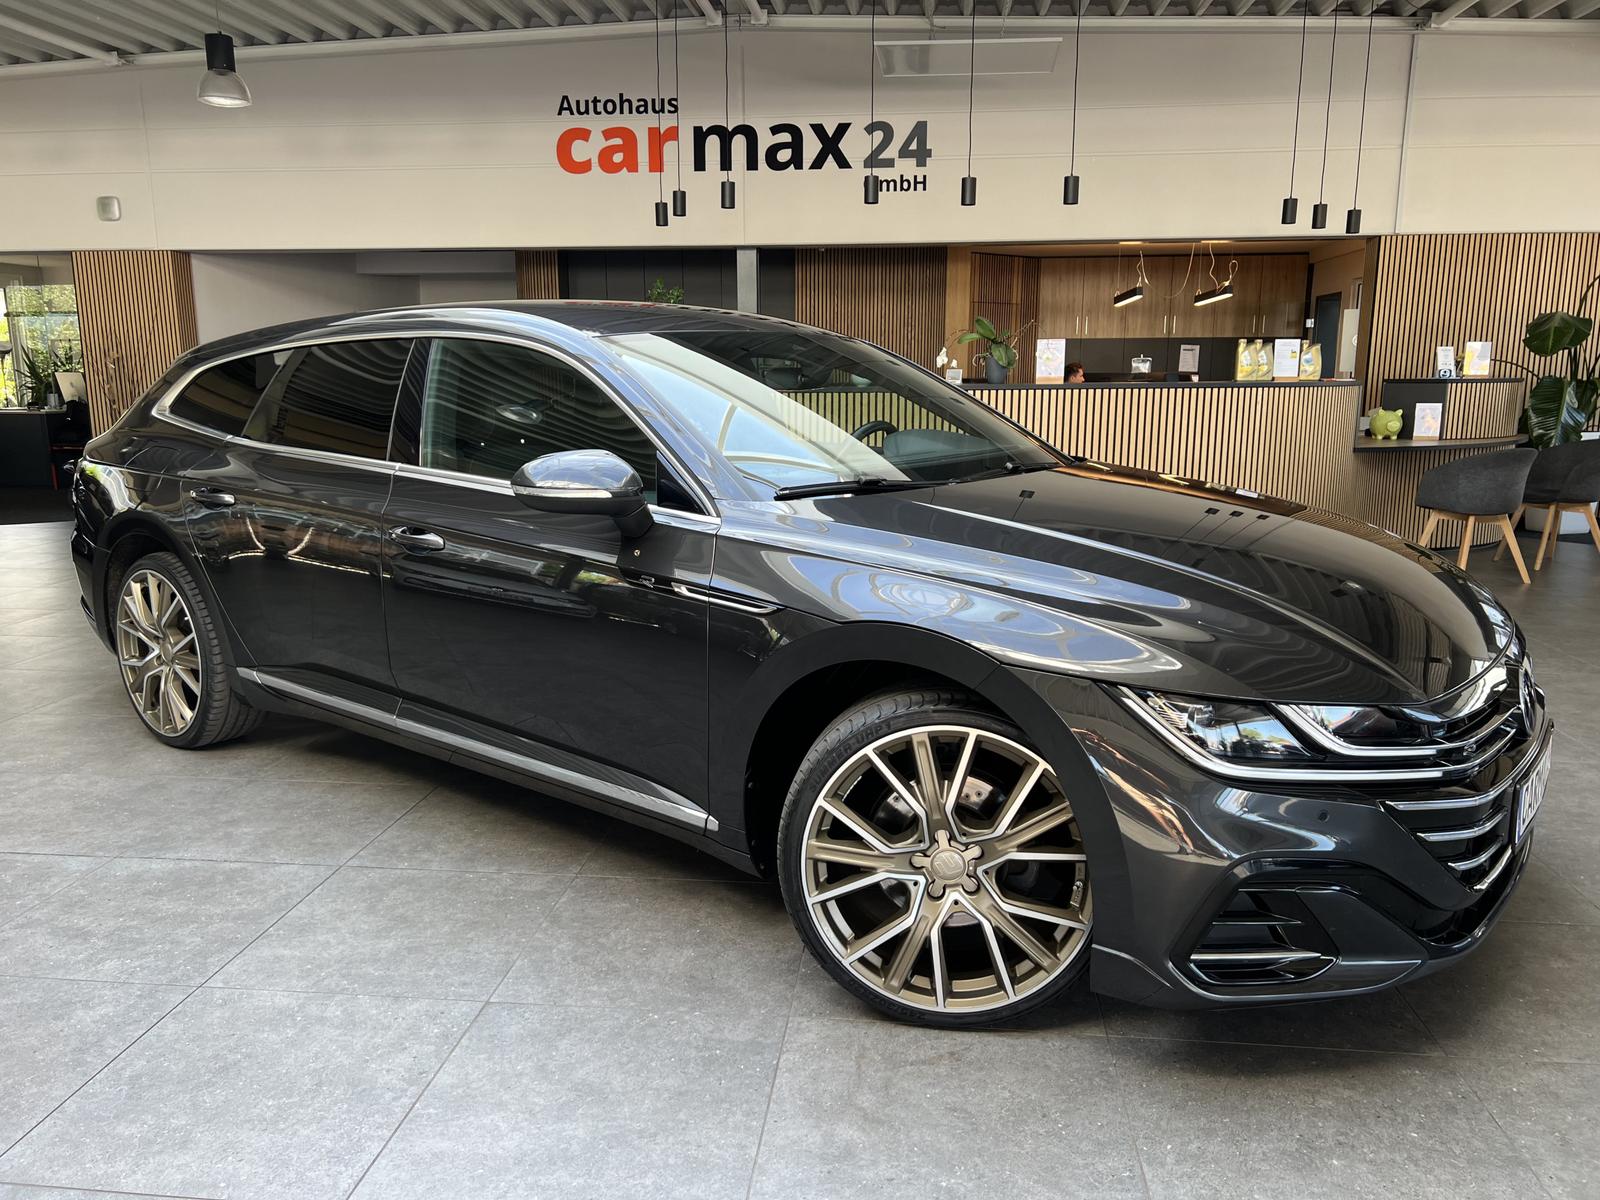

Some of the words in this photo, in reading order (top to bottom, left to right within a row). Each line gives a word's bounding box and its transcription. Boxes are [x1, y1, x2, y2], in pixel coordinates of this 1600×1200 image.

[557, 93, 679, 116] Autohaus
[556, 126, 679, 174] car
[693, 122, 853, 172] max
[862, 120, 932, 168] 24
[863, 174, 927, 192] mbH
